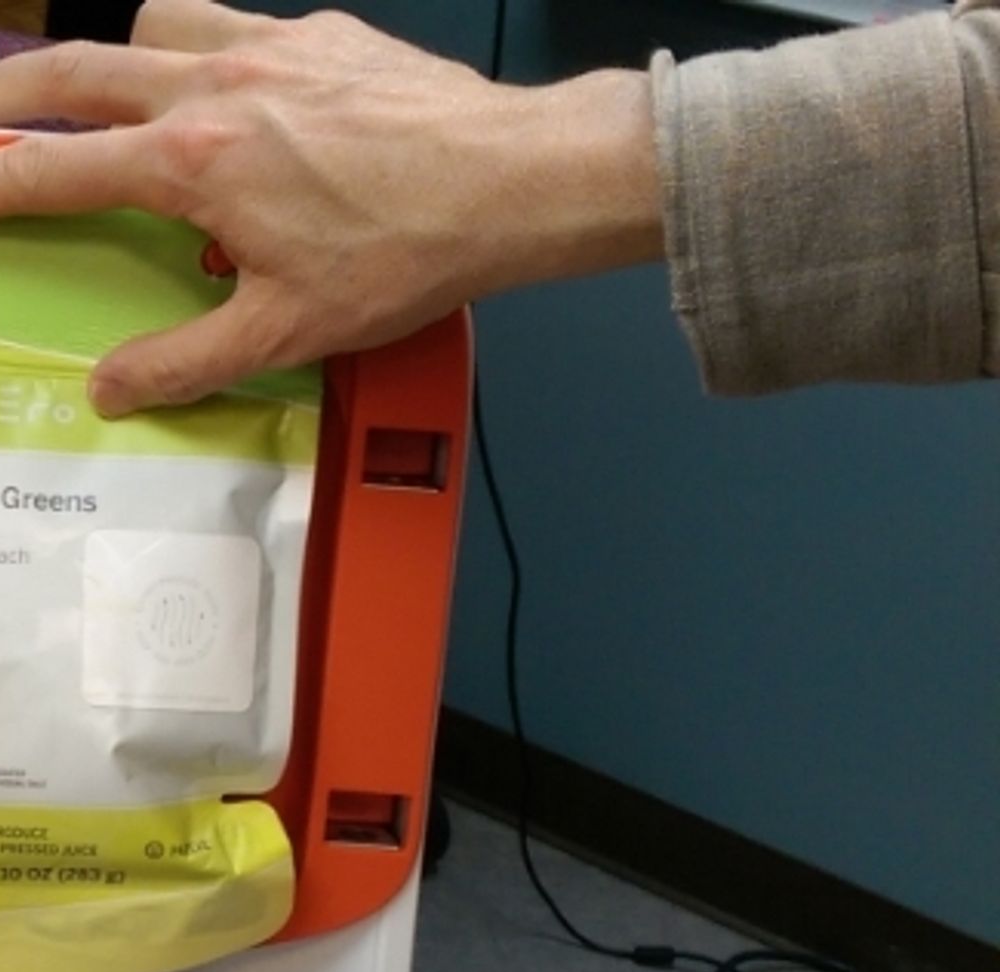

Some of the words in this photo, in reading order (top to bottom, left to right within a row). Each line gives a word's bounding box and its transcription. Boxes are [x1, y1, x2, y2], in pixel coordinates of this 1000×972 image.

[1, 486, 98, 512] Greens
[1, 867, 22, 881] 10
[26, 867, 53, 881] OZ
